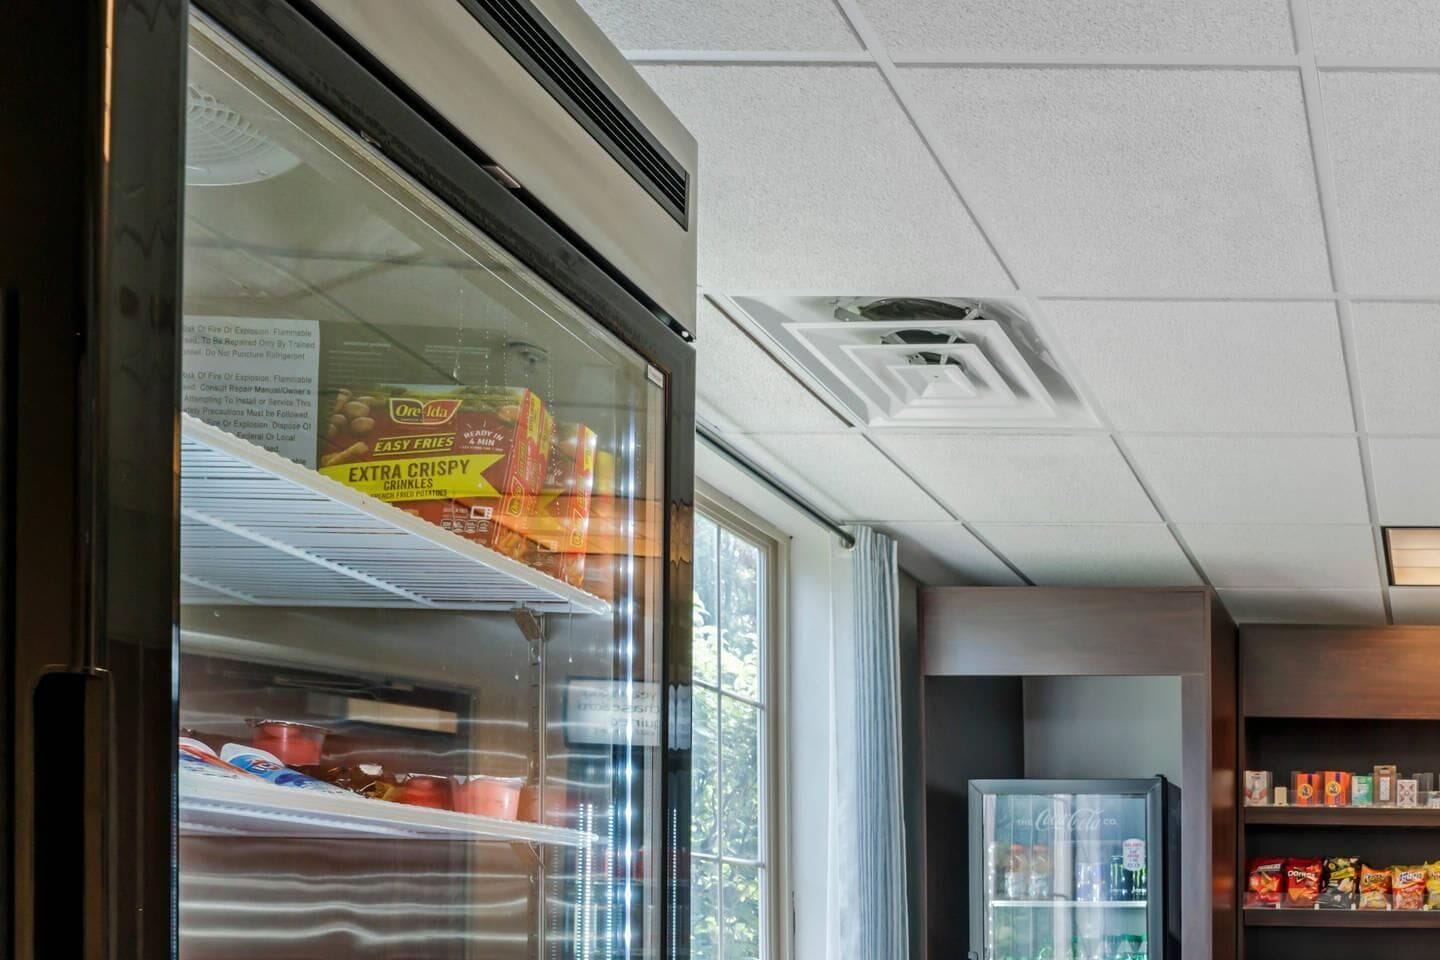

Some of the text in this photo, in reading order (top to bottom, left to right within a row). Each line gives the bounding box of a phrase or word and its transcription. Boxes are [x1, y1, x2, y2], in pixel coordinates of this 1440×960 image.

[273, 327, 312, 337] Flammable
[224, 337, 257, 347] Repaired
[288, 341, 316, 349] Trained
[205, 349, 216, 357] Do
[217, 349, 231, 357] Not
[232, 350, 264, 358] Puncture
[197, 371, 207, 379] Of
[208, 372, 222, 380] Fire
[224, 372, 233, 380] Or
[273, 375, 313, 383] Flammable
[200, 383, 228, 392] Consult
[229, 384, 253, 394] Repair
[224, 395, 234, 404] To
[268, 398, 295, 407] Service
[296, 399, 311, 408] This
[202, 407, 245, 416] Precautions
[246, 408, 264, 418] Must
[271, 421, 301, 431] Dispose
[265, 432, 275, 441] Or
[276, 432, 297, 442] Local
[463, 430, 504, 441] READY IN
[374, 436, 454, 453] EASY FRIES
[476, 438, 496, 447] MIN
[349, 458, 471, 483] EXTRA CRISPY
[383, 478, 434, 492] CRINKLES
